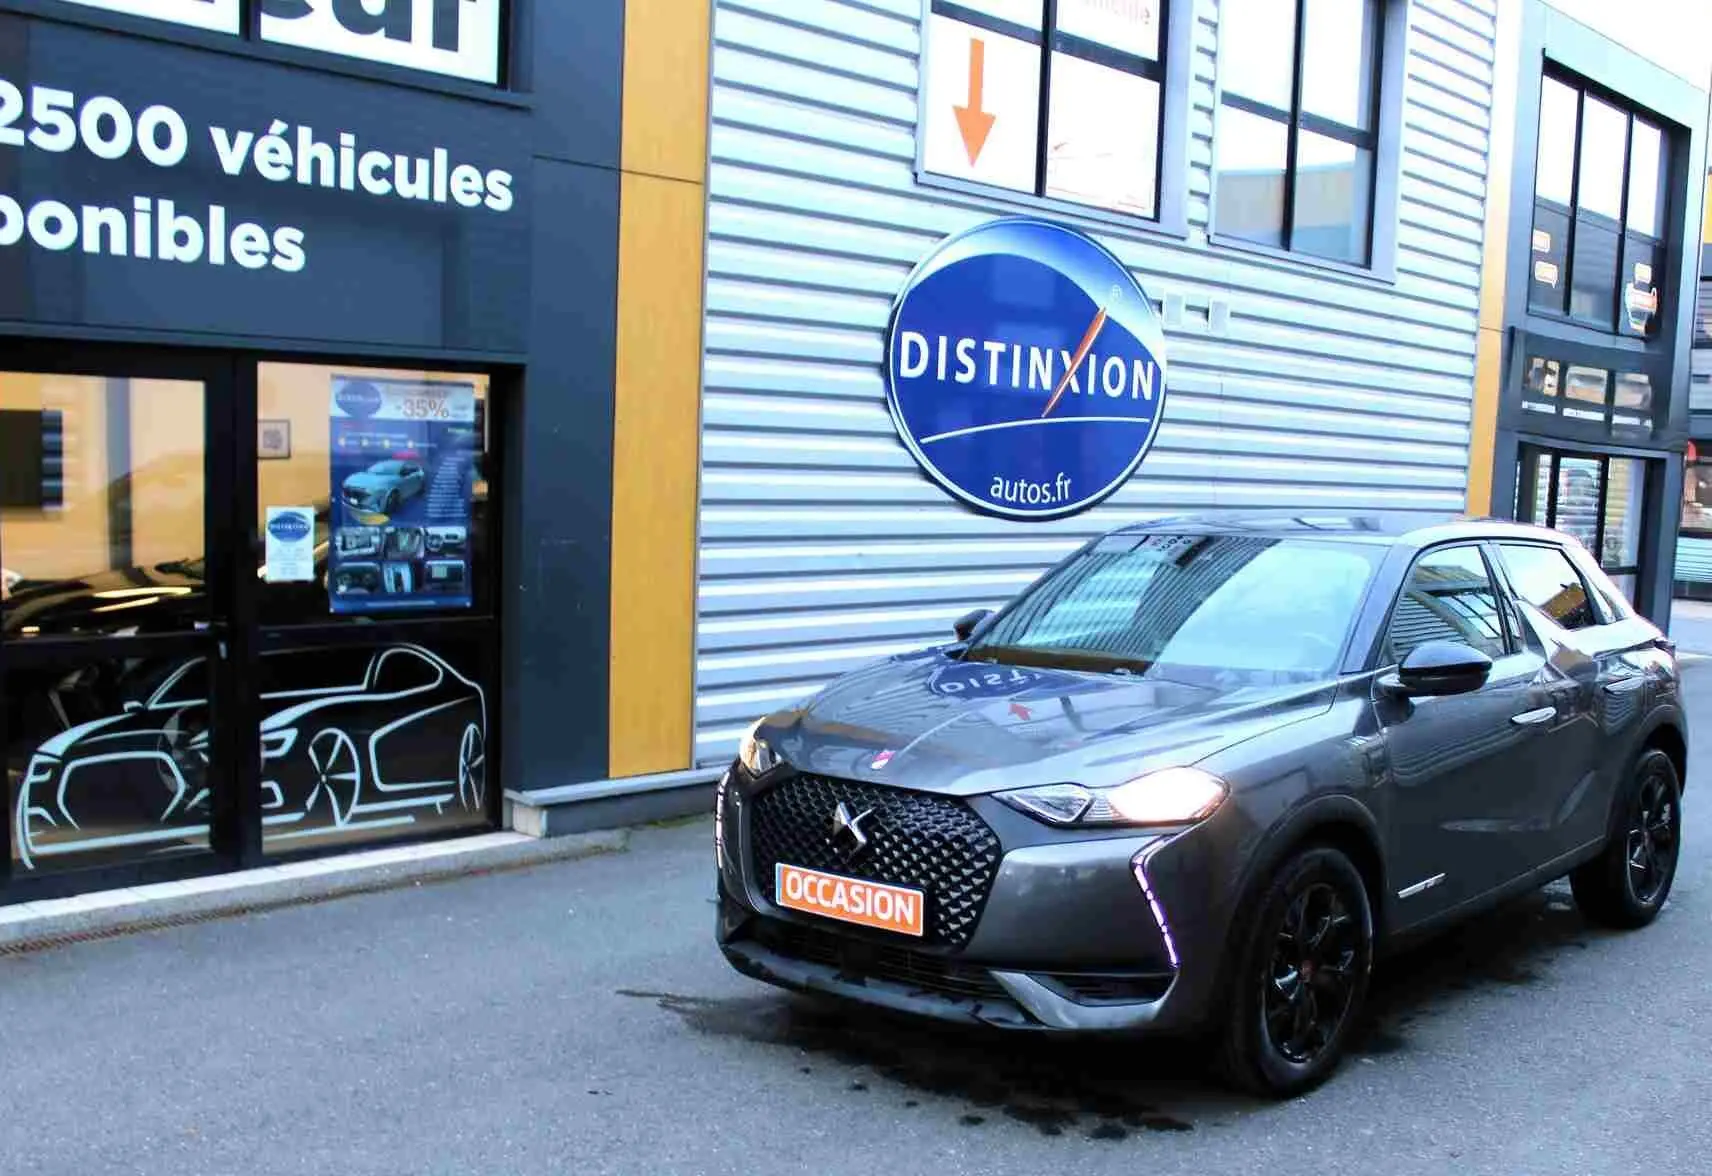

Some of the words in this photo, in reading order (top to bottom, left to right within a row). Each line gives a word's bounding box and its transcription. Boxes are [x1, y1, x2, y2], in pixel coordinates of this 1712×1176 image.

[209, 118, 513, 212] véhicules
[900, 330, 1156, 402] DISTINXION
[990, 471, 1073, 505] autos.fr
[785, 871, 915, 926] OCCASION
